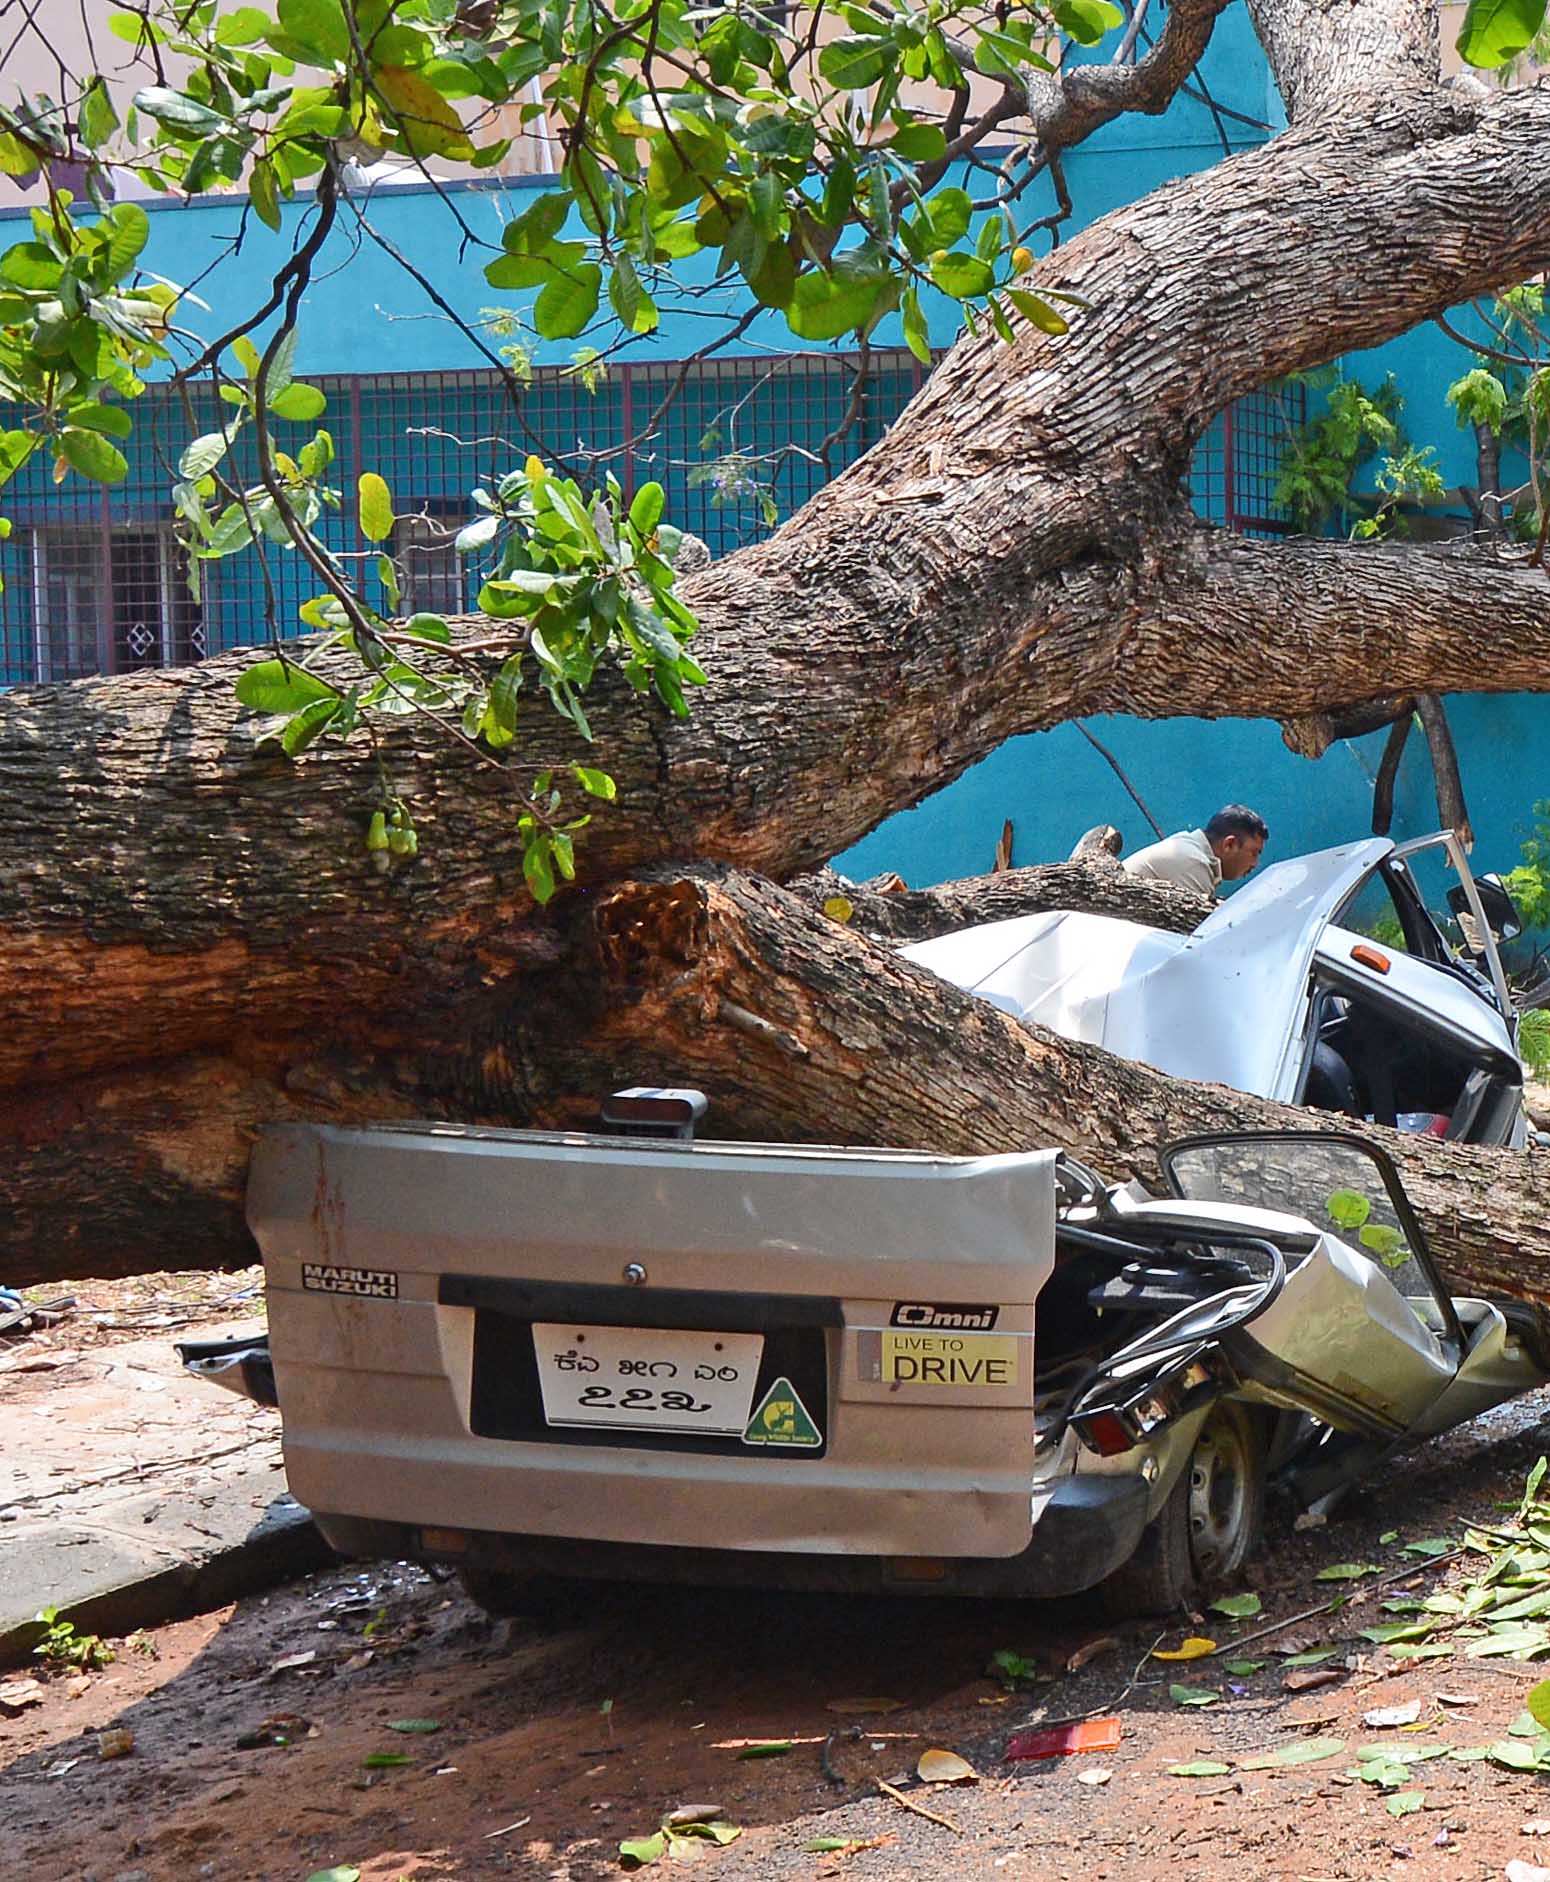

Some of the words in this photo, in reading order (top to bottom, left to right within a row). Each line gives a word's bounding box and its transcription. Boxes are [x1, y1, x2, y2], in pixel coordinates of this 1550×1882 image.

[304, 1264, 396, 1285] MARUTI
[304, 1277, 396, 1297] SUZUKI
[896, 1304, 993, 1328] Omni
[894, 1336, 933, 1351] LIVE
[939, 1338, 964, 1352] TO
[894, 1355, 1008, 1384] DRIVE
